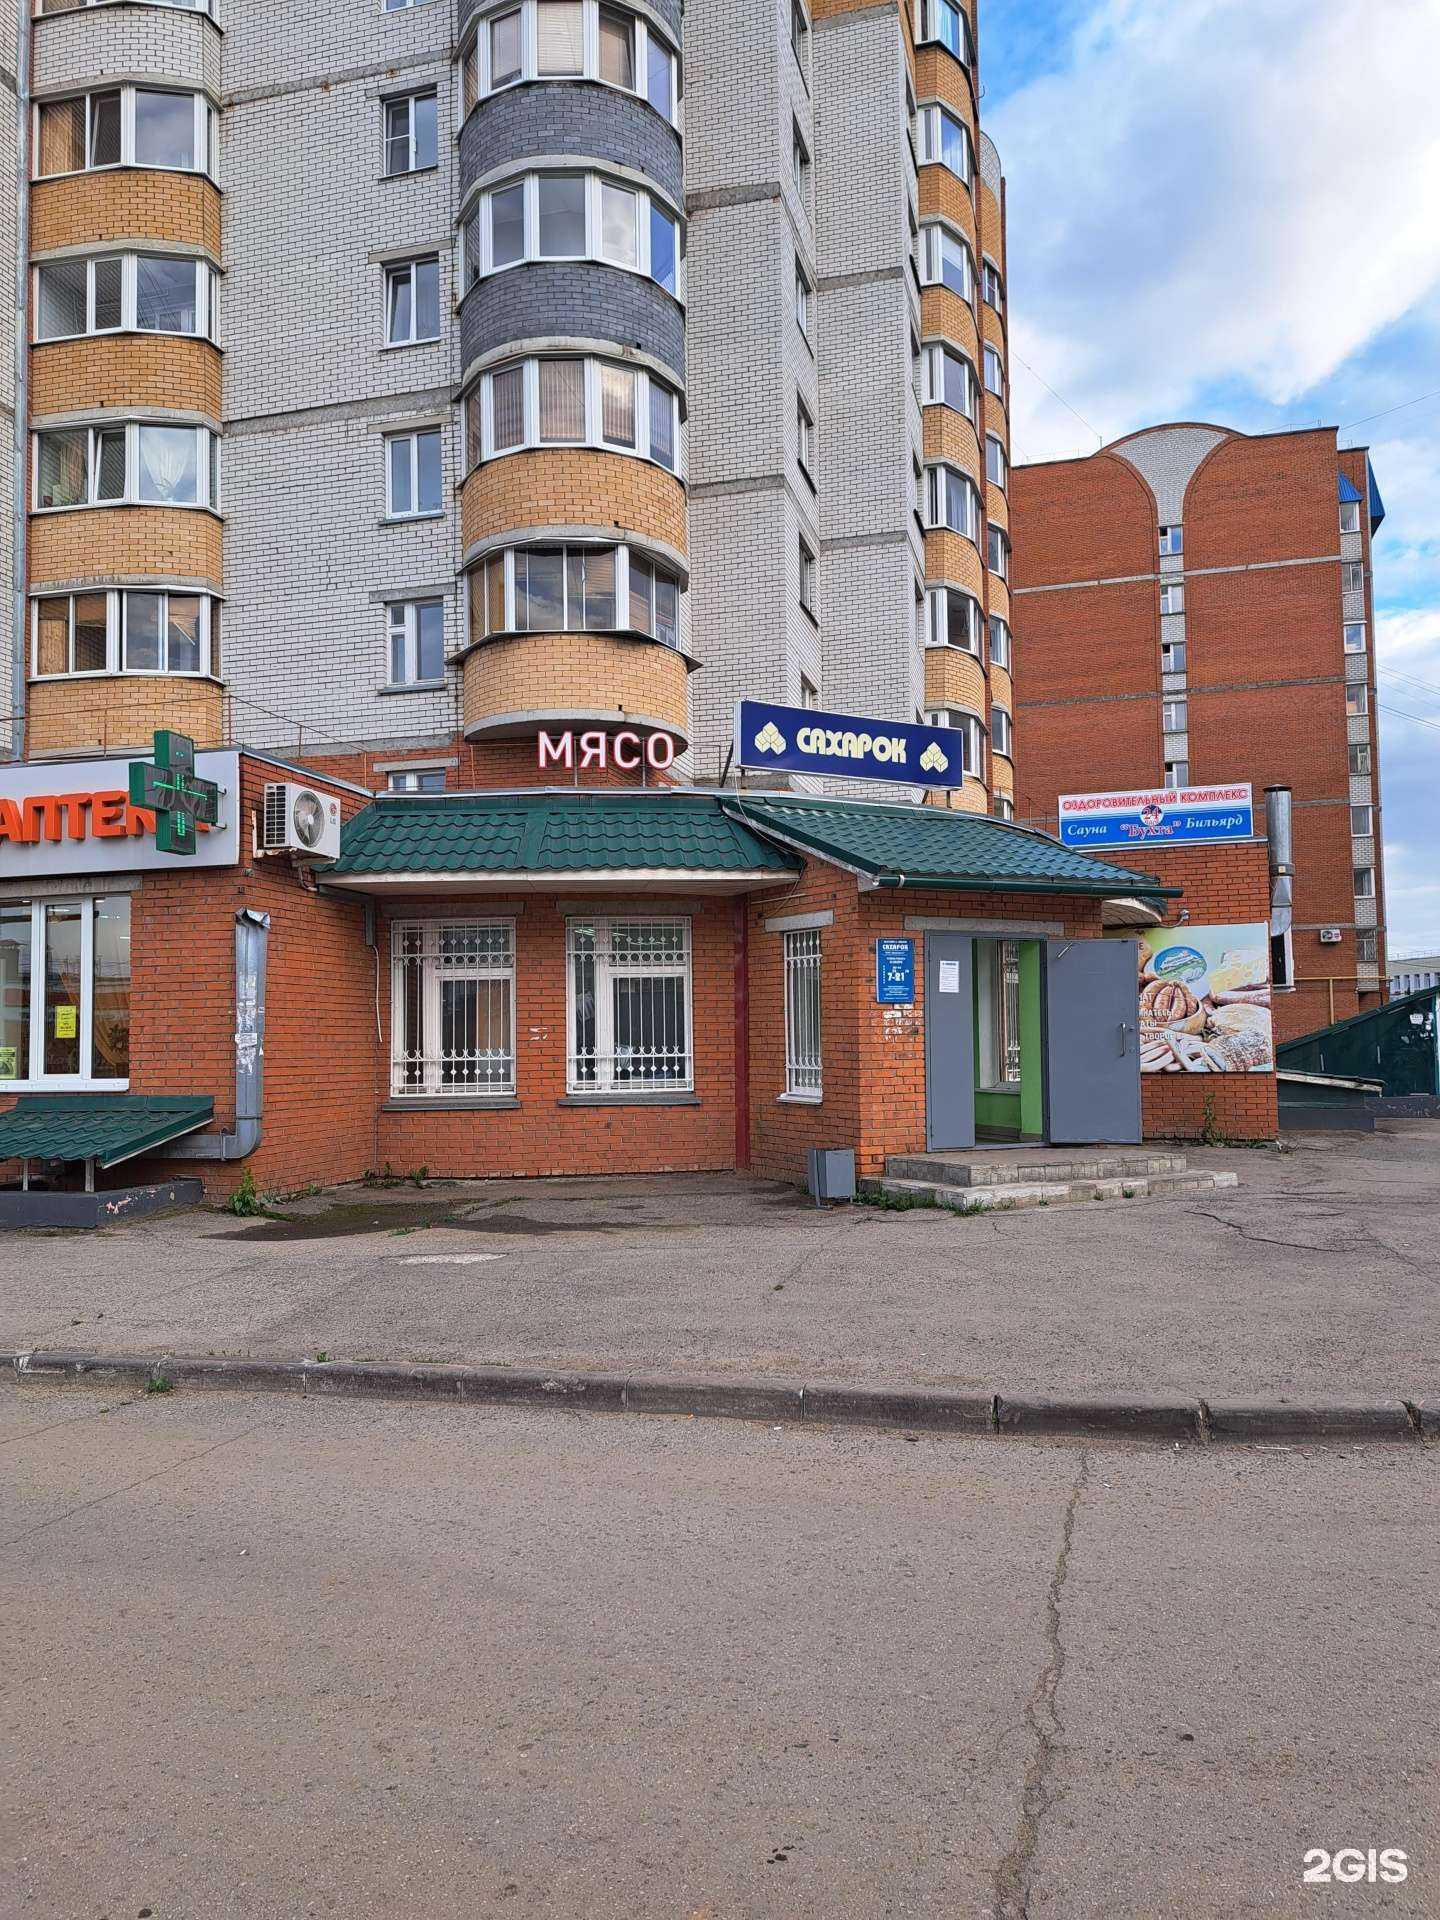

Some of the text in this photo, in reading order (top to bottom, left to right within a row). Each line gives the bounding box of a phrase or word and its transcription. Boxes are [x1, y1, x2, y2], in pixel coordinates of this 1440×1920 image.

[537, 729, 675, 770] МЯСО
[796, 727, 907, 763] САХАРОК
[0, 789, 209, 843] АПТЕК
[1063, 789, 1249, 812] ОЗДОРОВИТЕЛЬНЫЙ КОМПЛЕКС
[1067, 824, 1108, 837] Сауна
[1186, 814, 1244, 829] Бильярд
